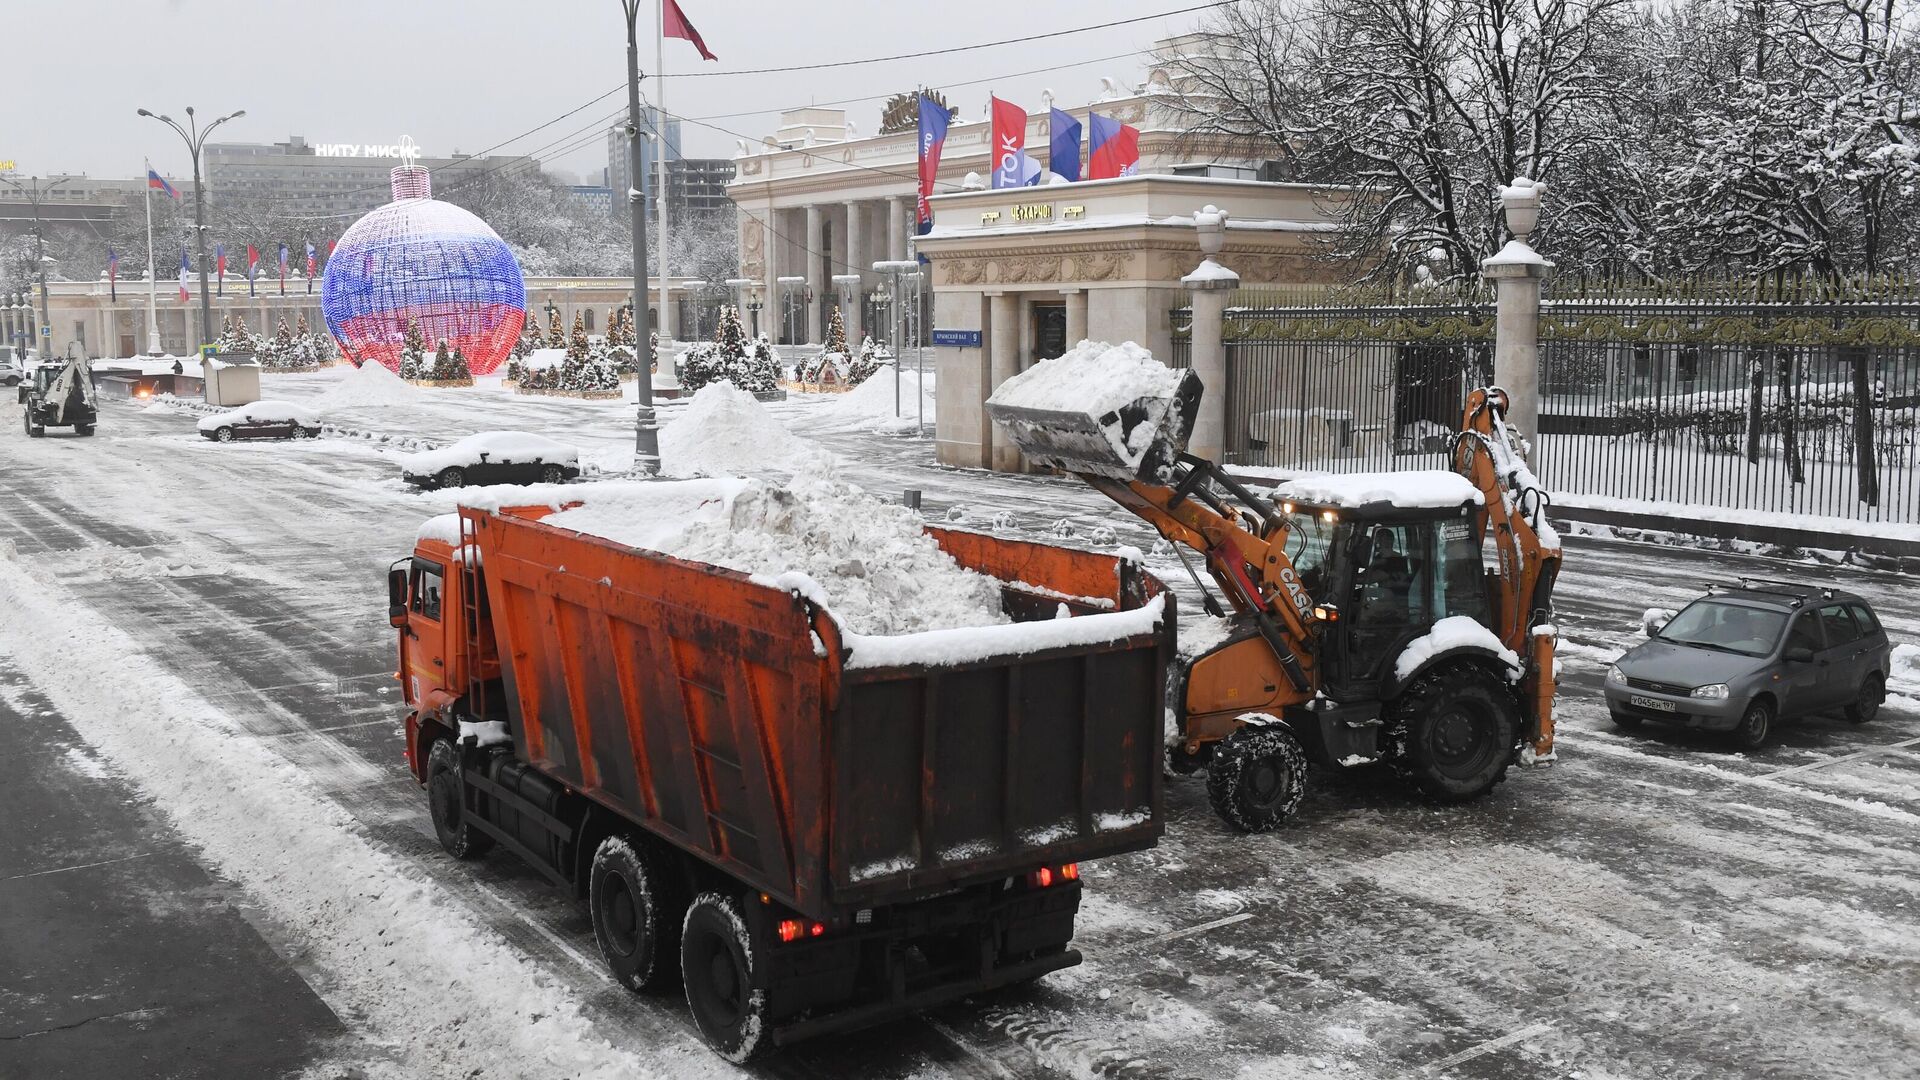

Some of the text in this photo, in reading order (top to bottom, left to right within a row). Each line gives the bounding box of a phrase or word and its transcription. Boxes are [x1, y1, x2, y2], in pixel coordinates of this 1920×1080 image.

[315, 143, 361, 157] НИТУ
[972, 333, 978, 342] 9
[1280, 567, 1315, 620] CASE
[1662, 701, 1675, 710] 197
